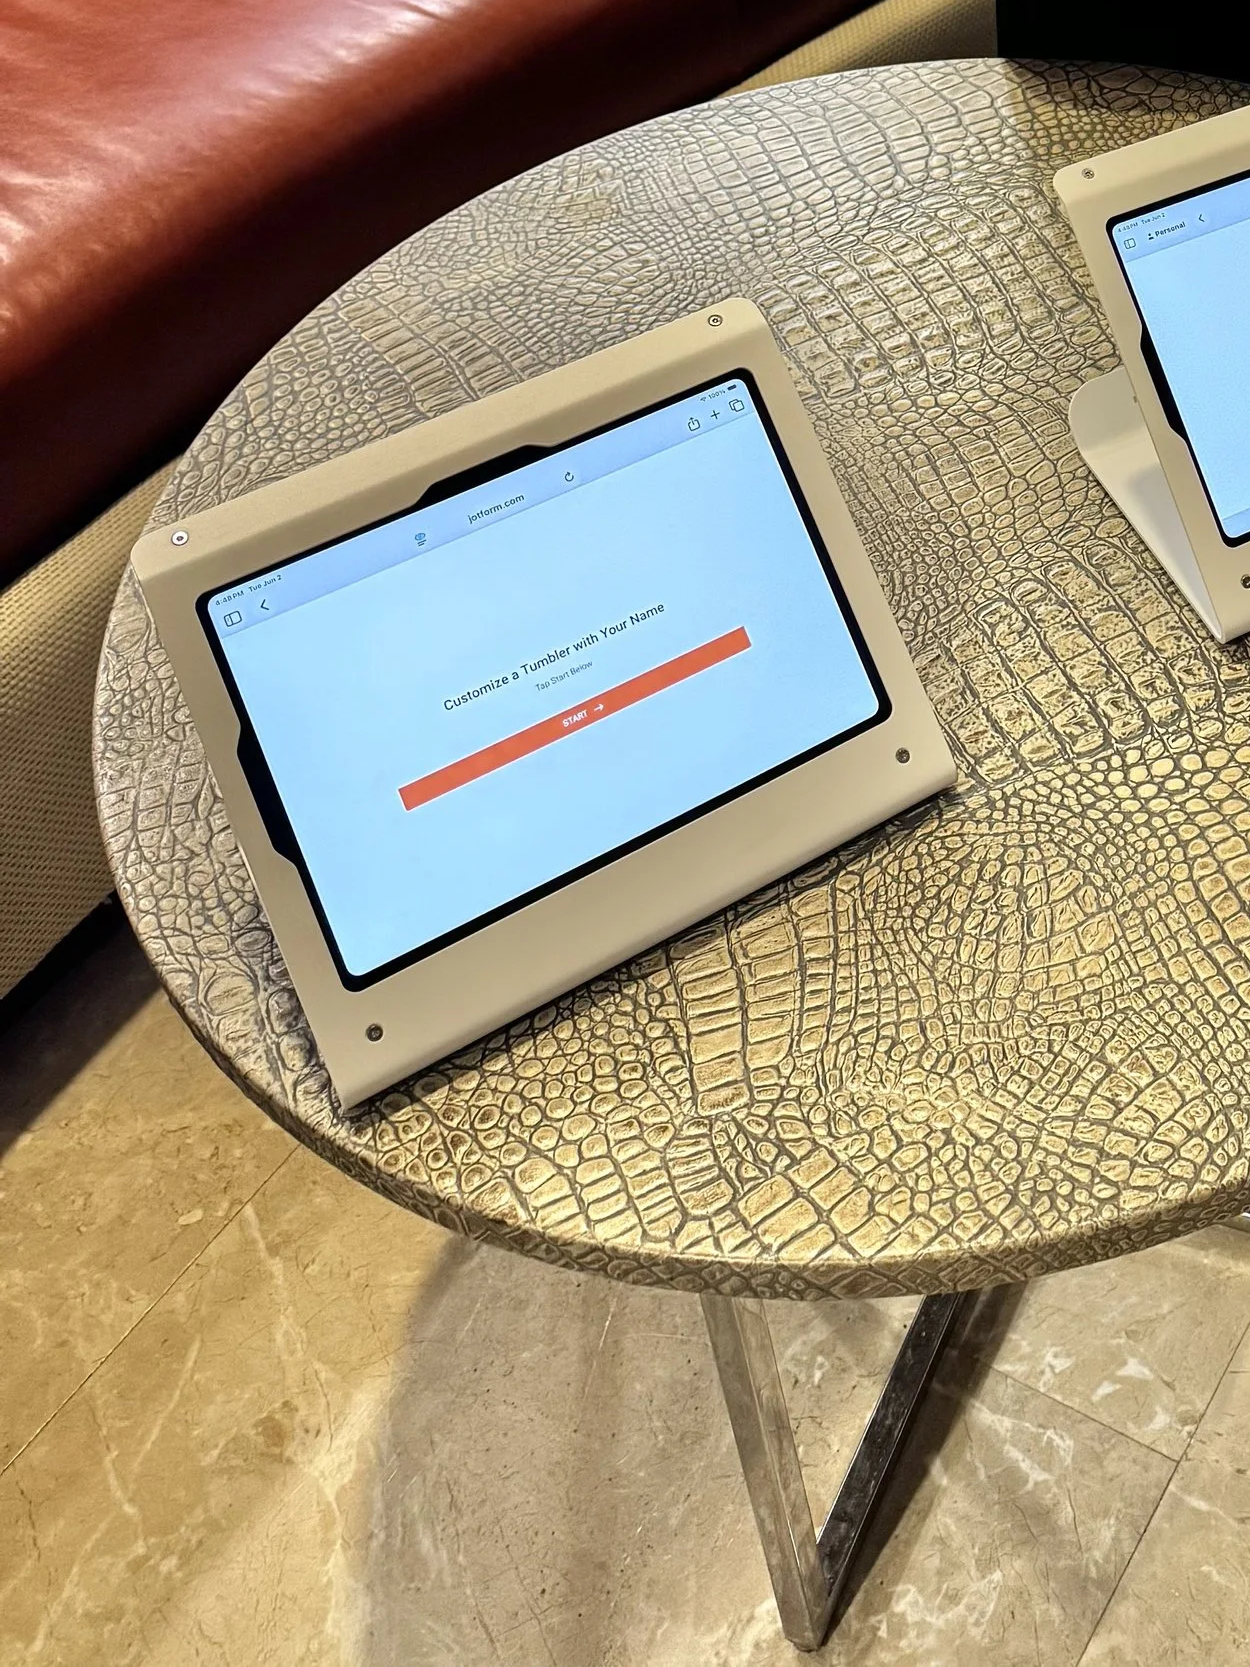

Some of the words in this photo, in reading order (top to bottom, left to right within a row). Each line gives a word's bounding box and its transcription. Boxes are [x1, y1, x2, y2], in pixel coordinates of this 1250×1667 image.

[1154, 221, 1186, 237] Personal
[467, 495, 525, 524] jotform.com
[263, 577, 277, 587] Jun
[443, 674, 510, 711] Customize
[511, 670, 520, 681] a
[520, 645, 571, 675] Tumbler
[572, 633, 599, 652] with
[599, 619, 628, 639] Your
[629, 603, 665, 626] Name
[535, 679, 550, 692] Tap
[549, 670, 570, 684] Start
[570, 659, 593, 676] Below
[562, 709, 589, 728] START
